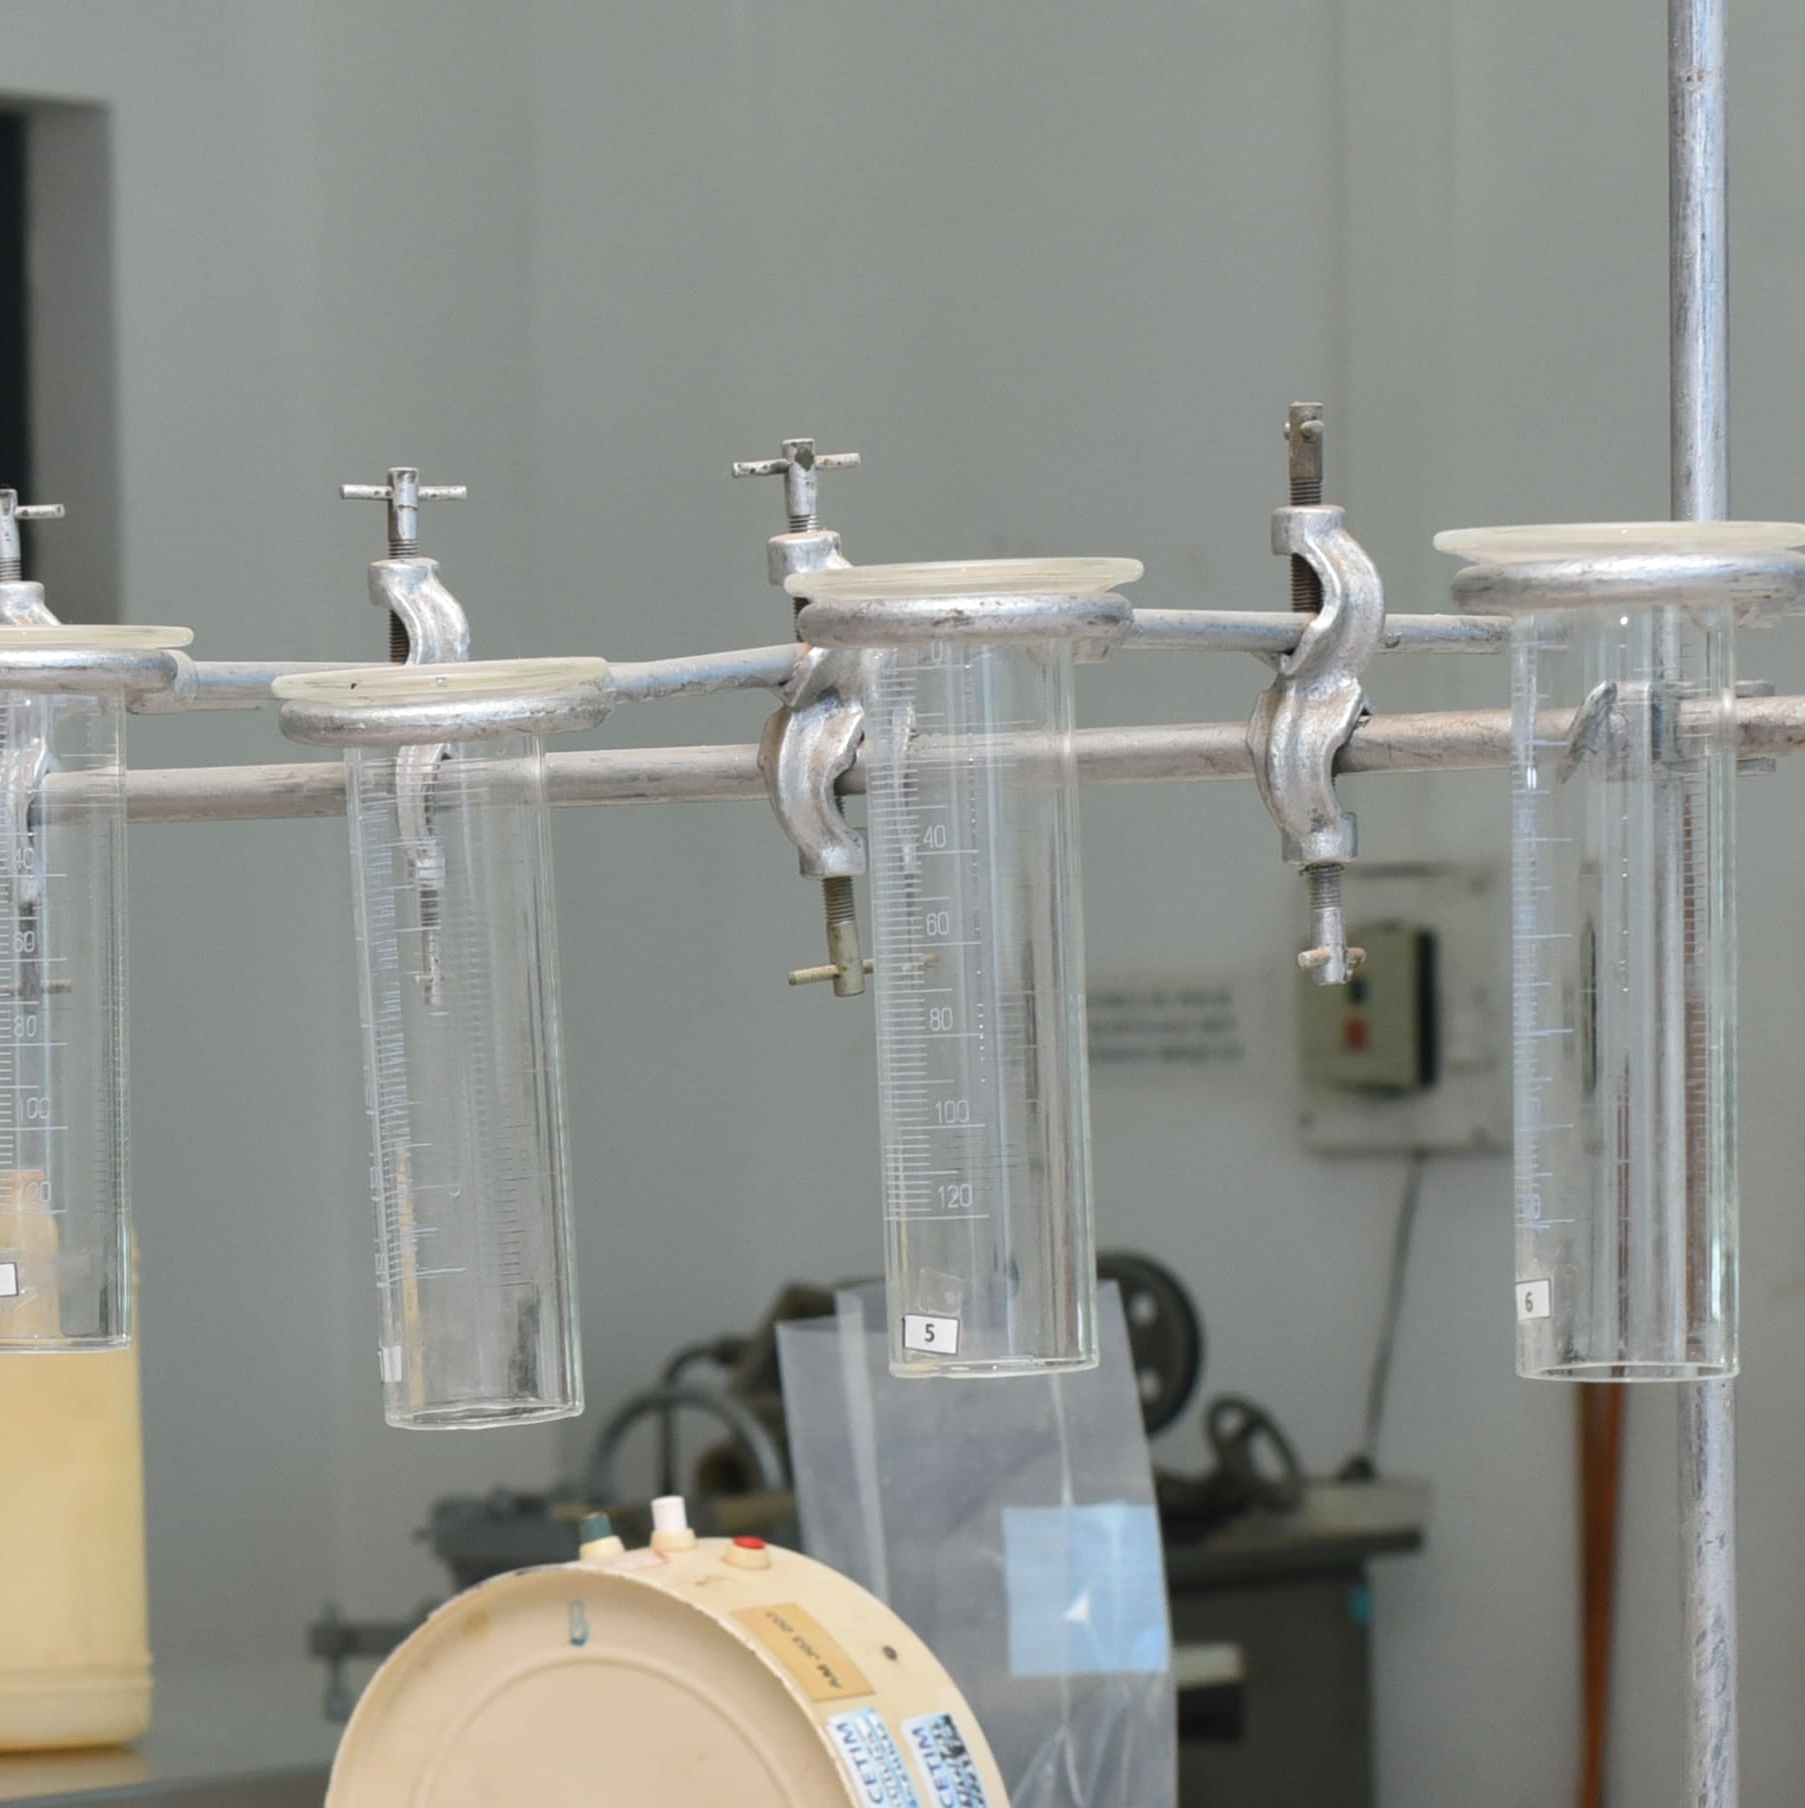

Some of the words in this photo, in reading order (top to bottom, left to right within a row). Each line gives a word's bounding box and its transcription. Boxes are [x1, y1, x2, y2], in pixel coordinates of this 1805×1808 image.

[923, 825, 947, 849] 40
[926, 911, 950, 936] 60
[13, 930, 36, 953] 60
[13, 1015, 38, 1037] 80
[929, 1007, 954, 1032] 80
[17, 1096, 51, 1120] 100
[935, 1100, 970, 1125] 100
[938, 1183, 973, 1209] 120
[1524, 1292, 1534, 1313] 6
[923, 1322, 937, 1344] 5
[836, 1721, 885, 1805] CETIM
